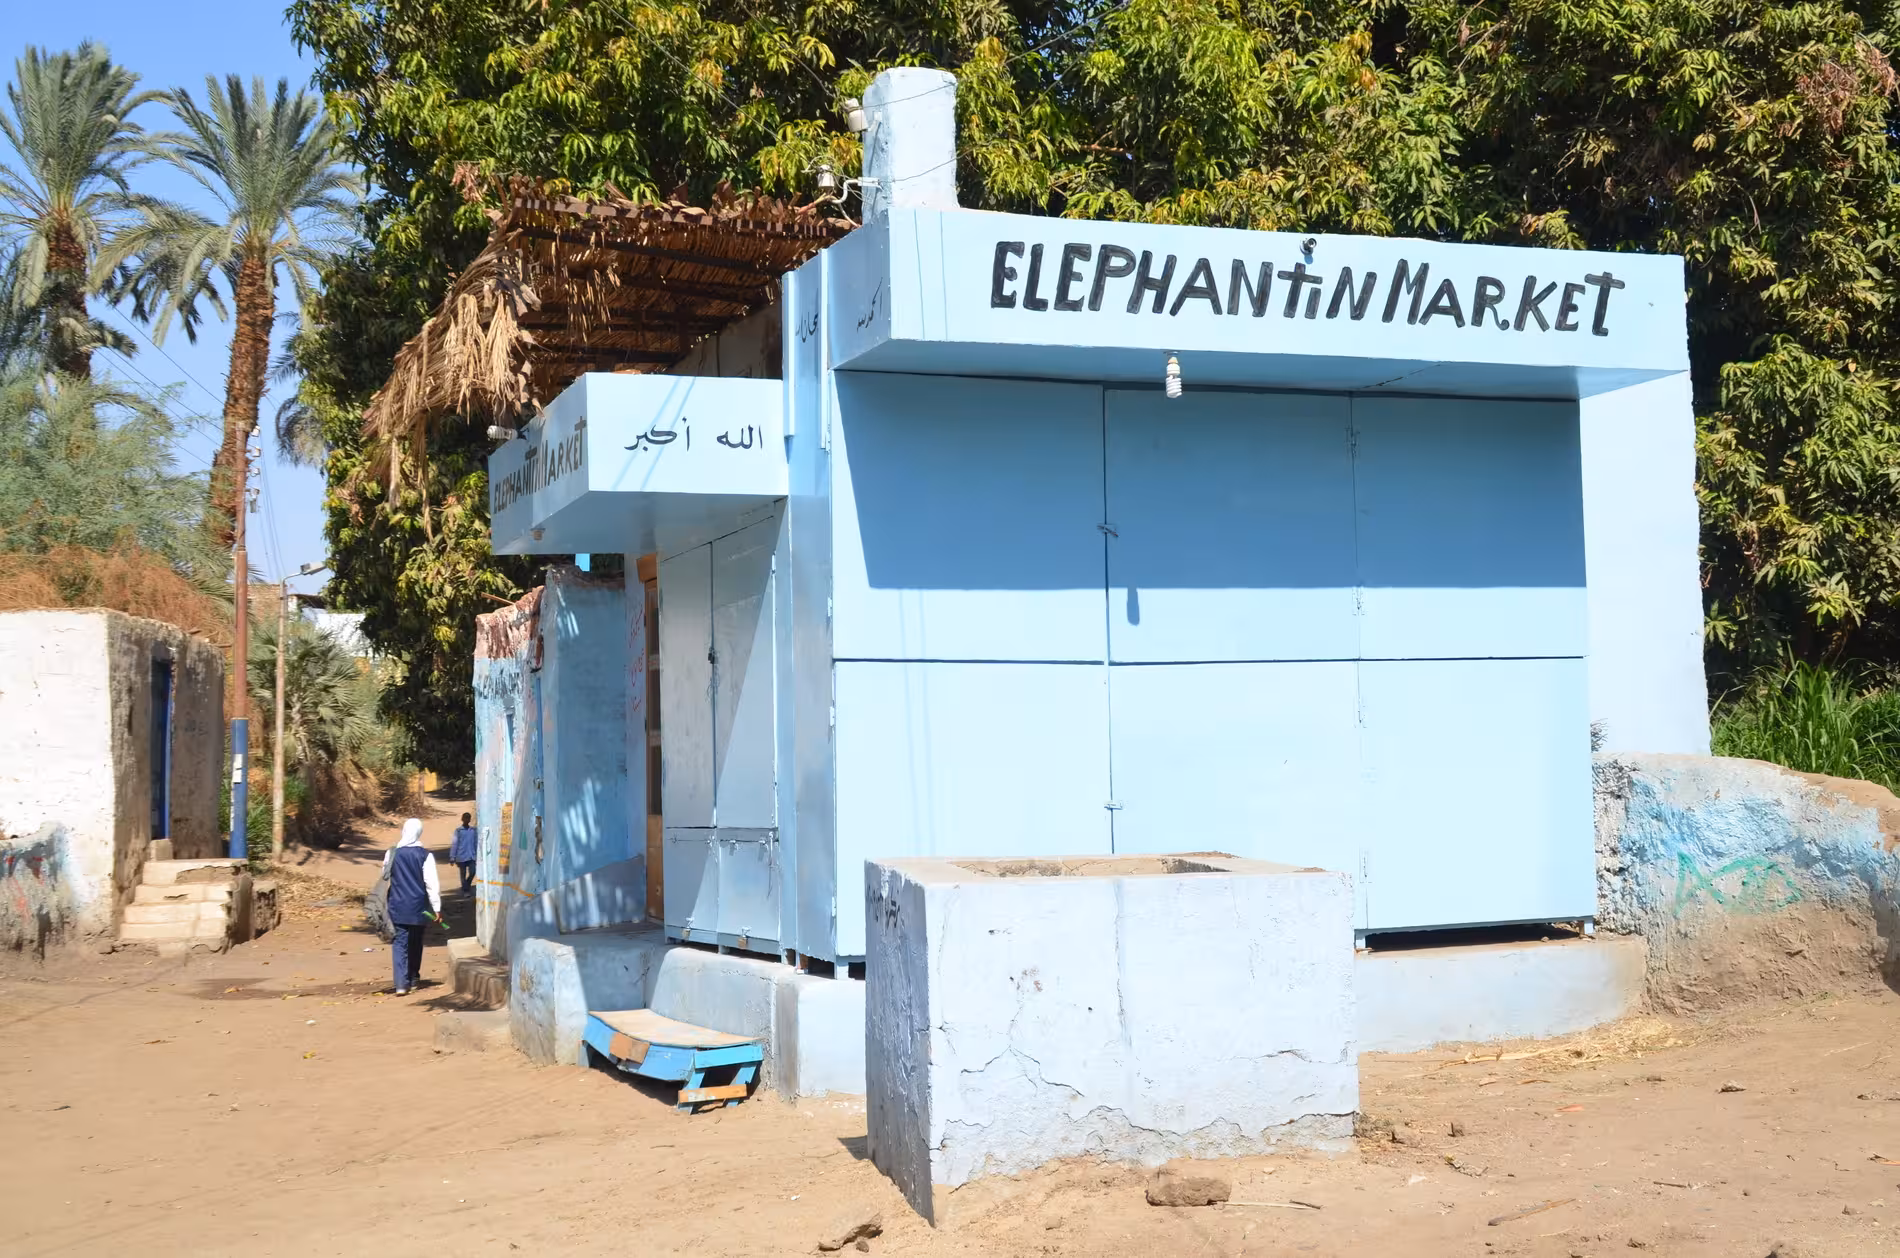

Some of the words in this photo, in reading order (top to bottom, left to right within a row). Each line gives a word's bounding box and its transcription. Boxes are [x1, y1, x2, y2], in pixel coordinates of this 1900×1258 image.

[1381, 258, 1626, 337] MARKET
[541, 415, 587, 488] MARKET
[624, 416, 691, 452] أكبر
[716, 424, 764, 451] الله
